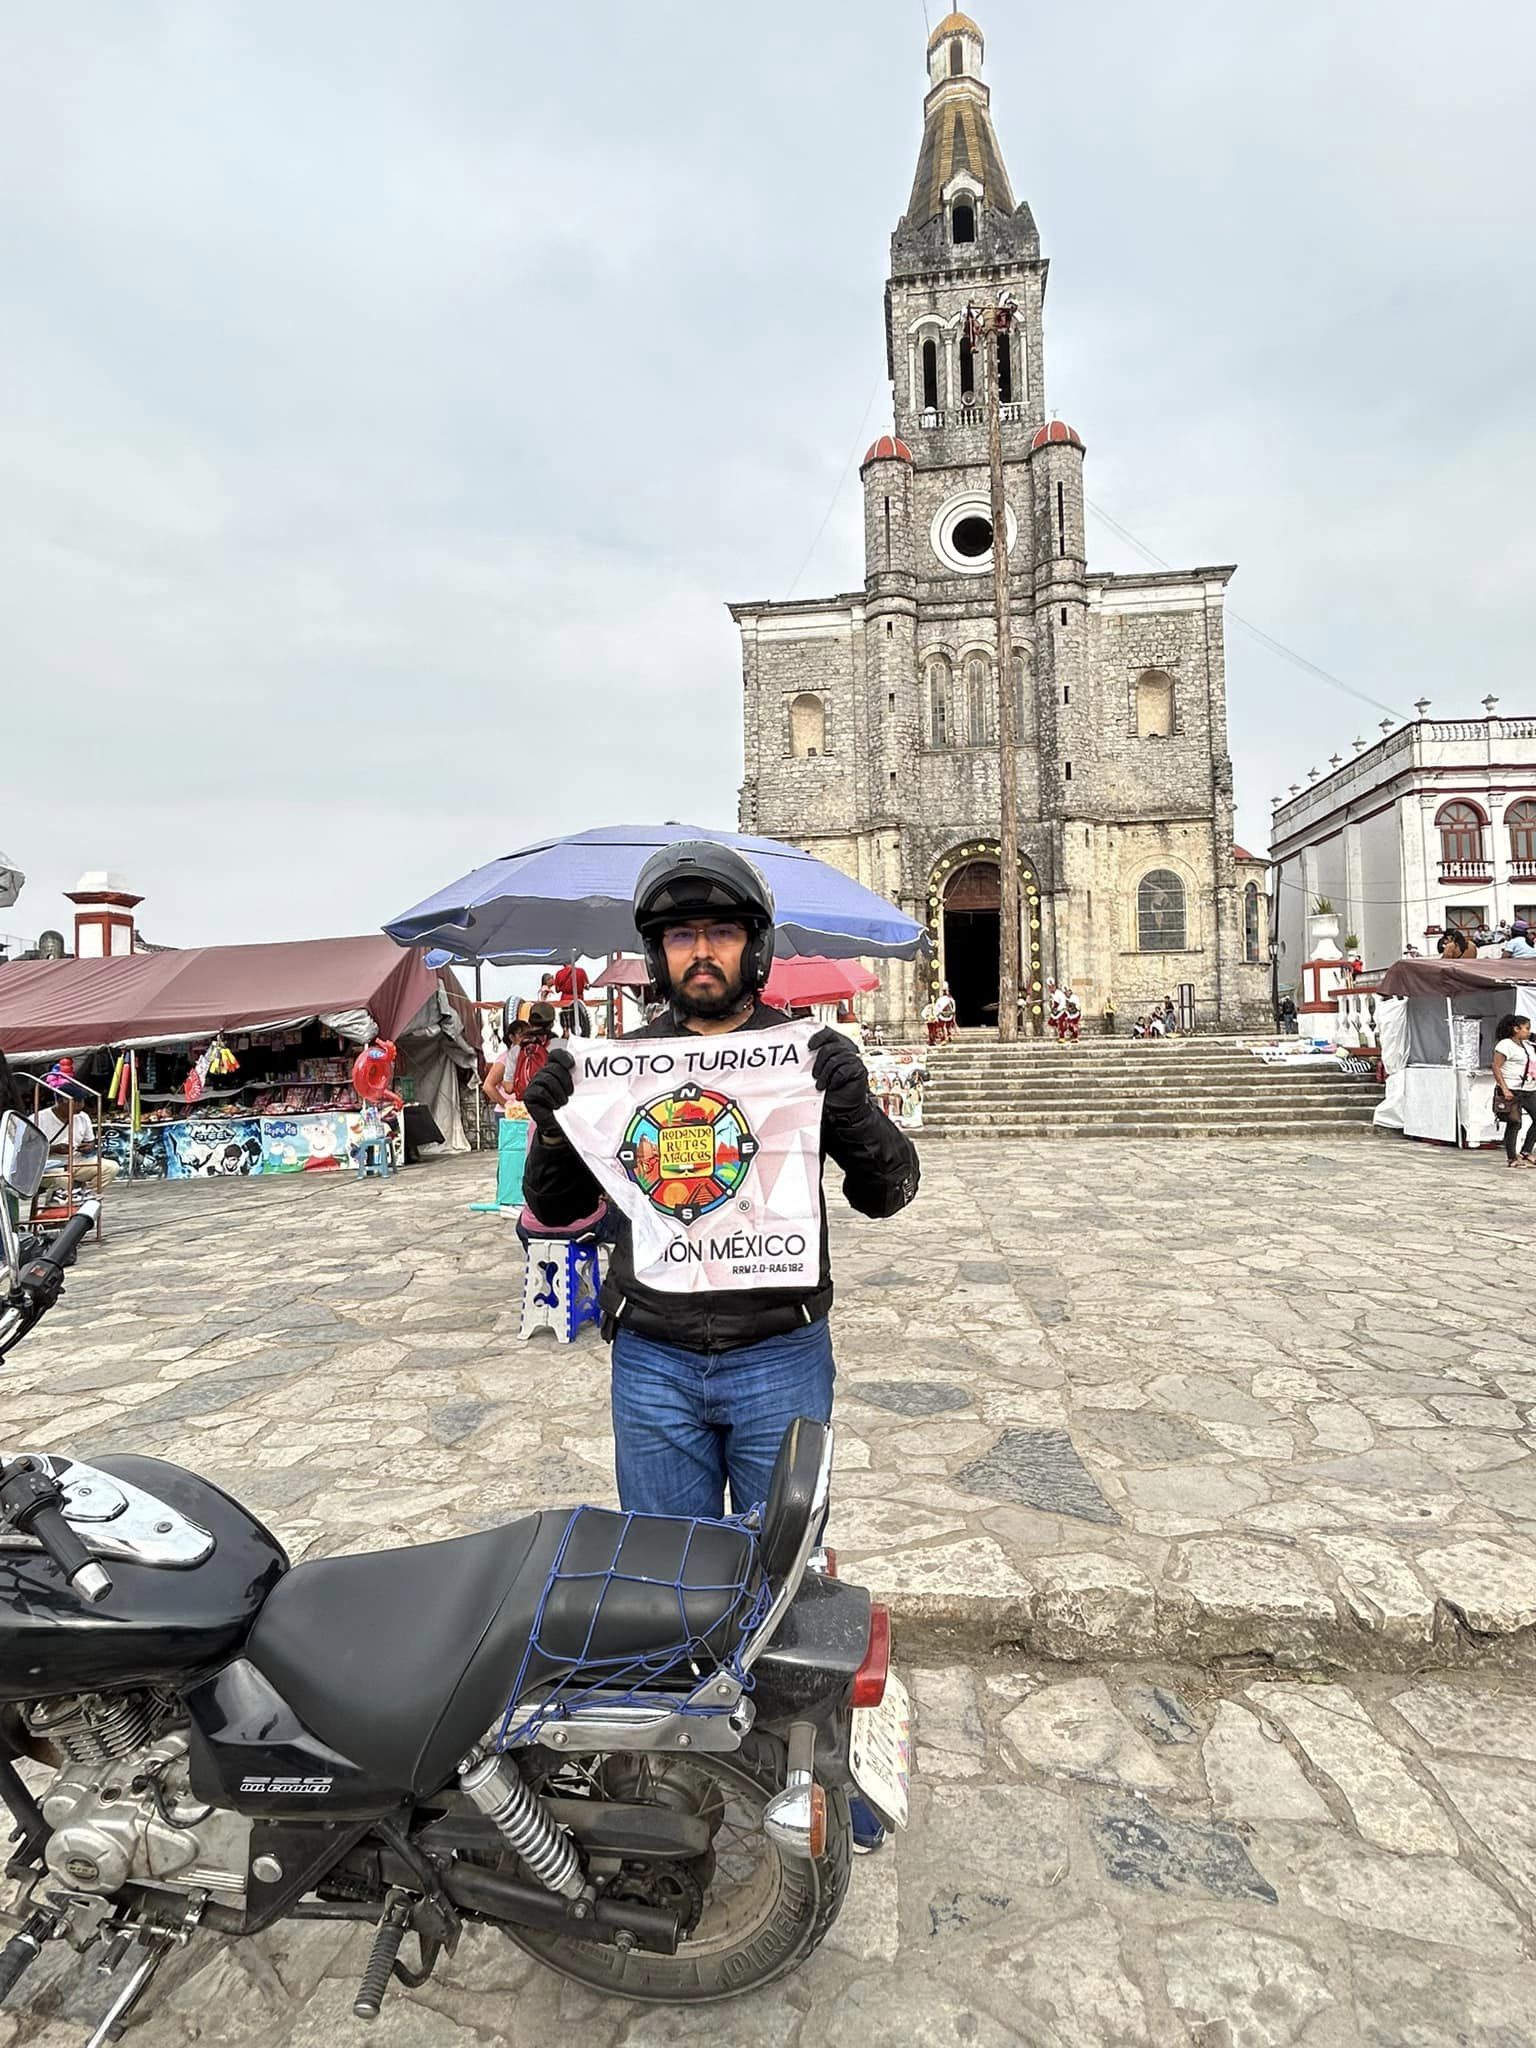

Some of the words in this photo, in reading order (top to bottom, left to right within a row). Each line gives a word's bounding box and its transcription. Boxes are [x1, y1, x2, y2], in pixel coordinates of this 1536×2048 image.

[584, 1054, 674, 1078] MOTO
[684, 1043, 800, 1073] TURISTA
[679, 1087, 697, 1099] N
[195, 1131, 229, 1141] STEEL
[741, 1141, 755, 1154] E
[681, 1208, 693, 1220] S
[661, 1234, 702, 1263] IÓN
[710, 1230, 806, 1261] MÉXICO
